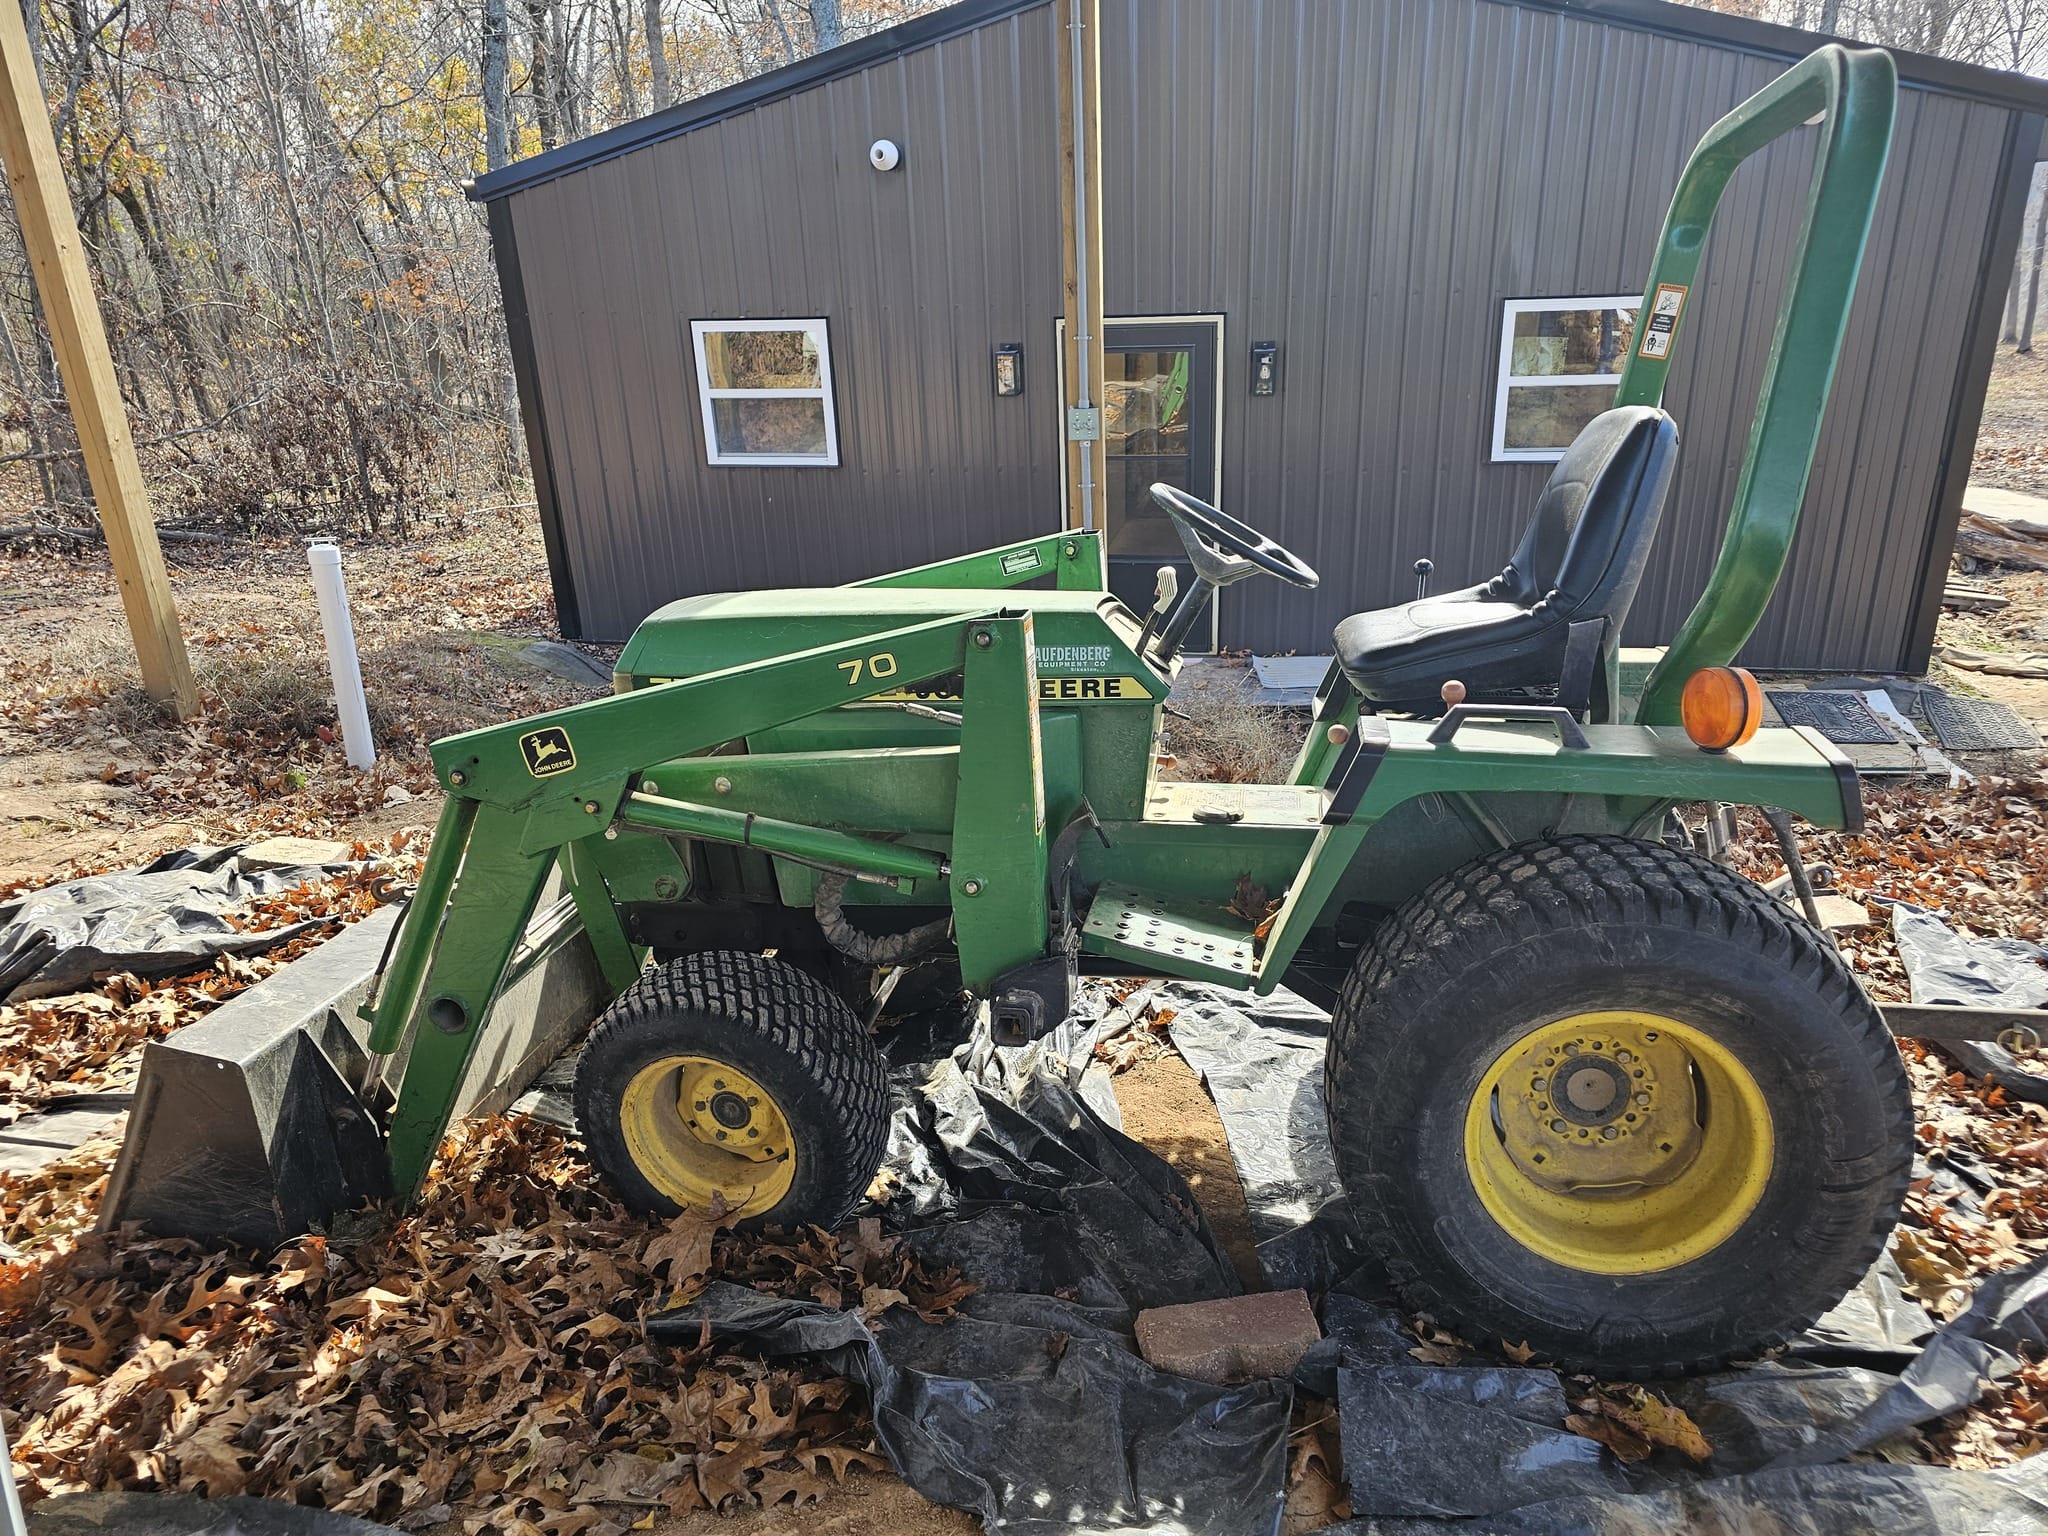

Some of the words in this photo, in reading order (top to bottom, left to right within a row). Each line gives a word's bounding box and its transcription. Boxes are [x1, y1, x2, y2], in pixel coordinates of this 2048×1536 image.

[1036, 646, 1111, 661] AUFDENBERG
[837, 652, 898, 686] 70
[1040, 679, 1121, 698] EERE
[534, 764, 552, 774] JOHN
[550, 759, 572, 769] DEERE
